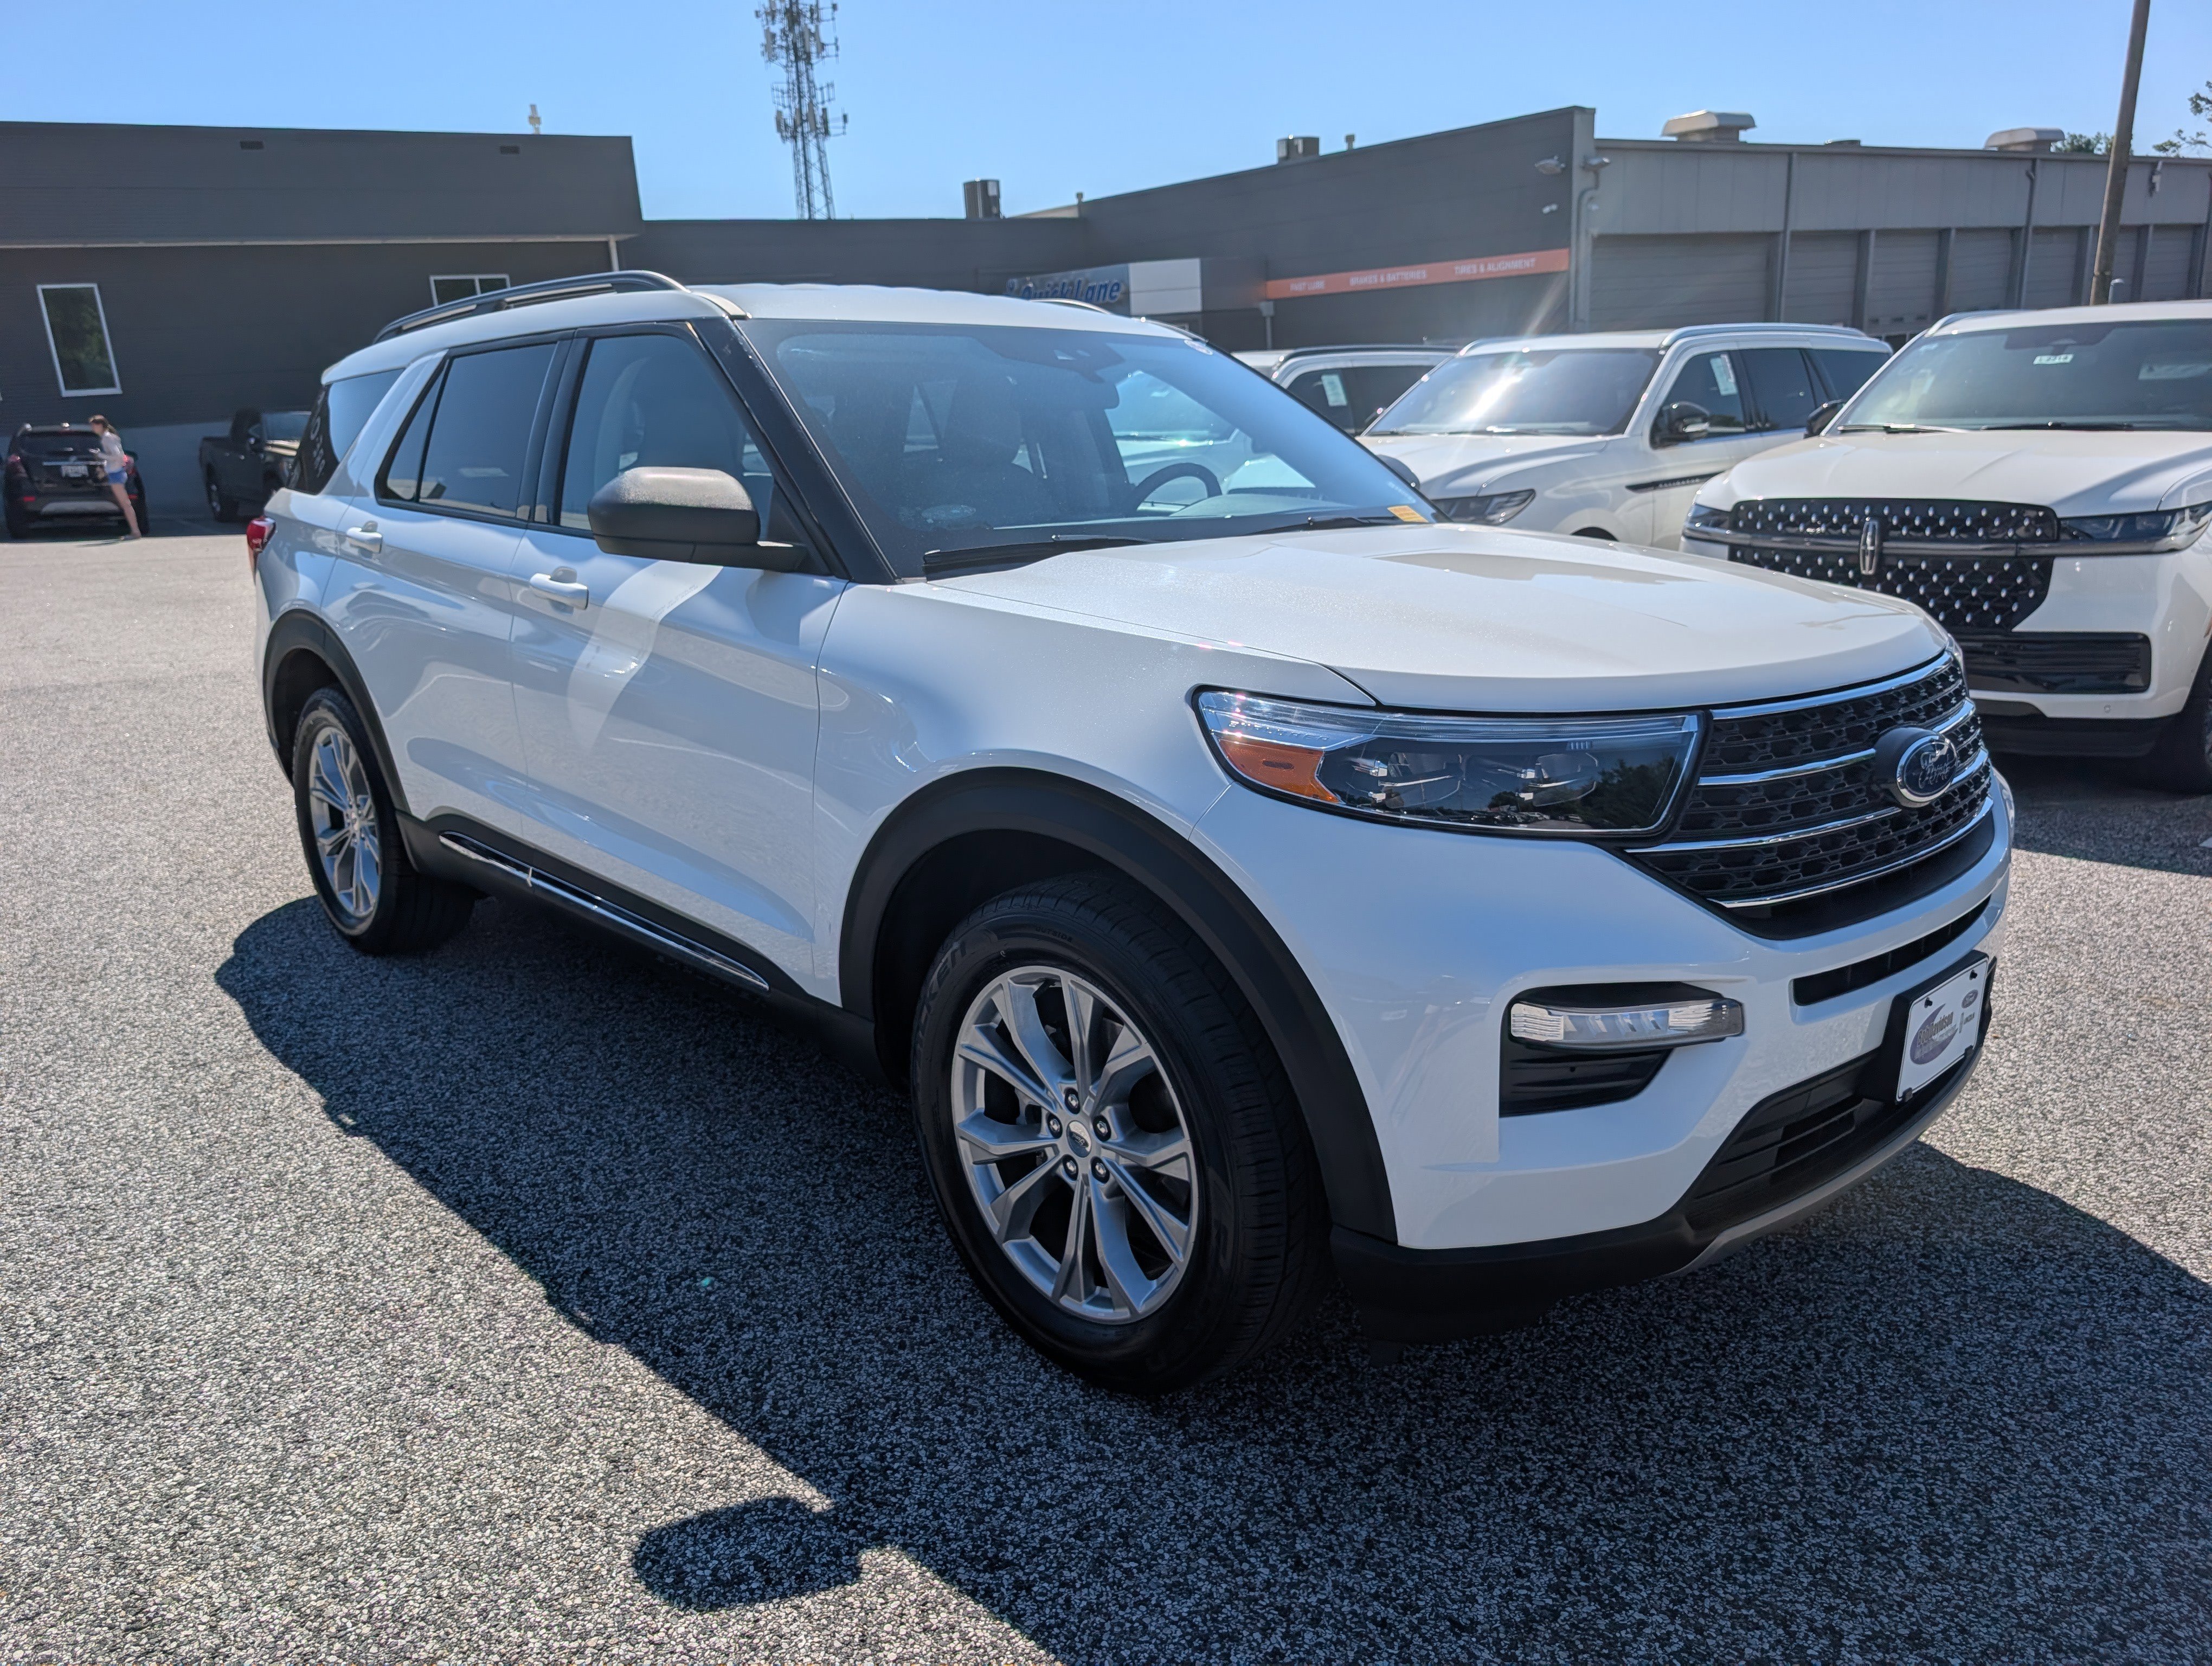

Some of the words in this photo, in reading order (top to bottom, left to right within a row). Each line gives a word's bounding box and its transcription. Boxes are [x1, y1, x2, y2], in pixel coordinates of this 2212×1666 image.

[1487, 258, 1536, 271] ALIGNMENT
[1349, 274, 1378, 286] BRAKES
[1386, 270, 1427, 282] BATTERIES
[1074, 279, 1121, 303] Lane
